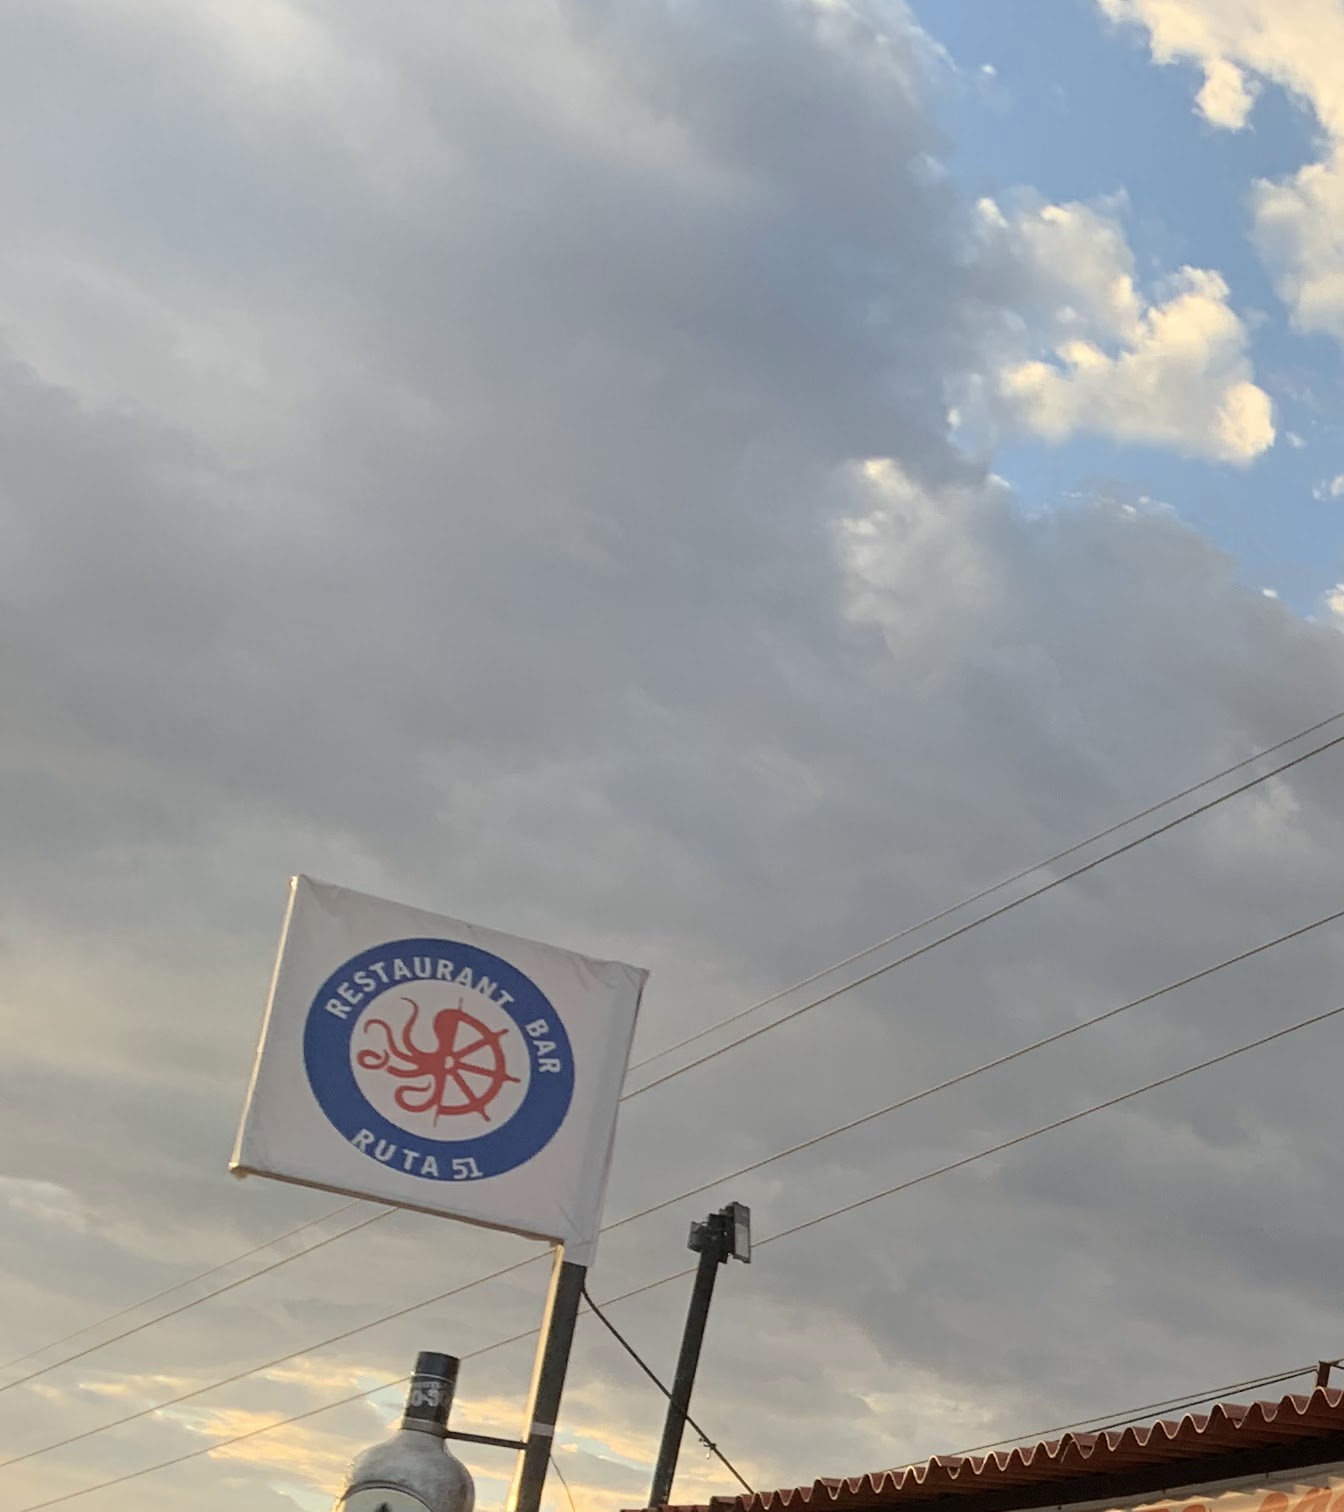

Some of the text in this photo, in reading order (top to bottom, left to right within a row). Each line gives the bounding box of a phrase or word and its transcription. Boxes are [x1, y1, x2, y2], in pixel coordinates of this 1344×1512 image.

[323, 956, 561, 1074] RESTAURANT BAR
[352, 1127, 484, 1180] RUTA 51
